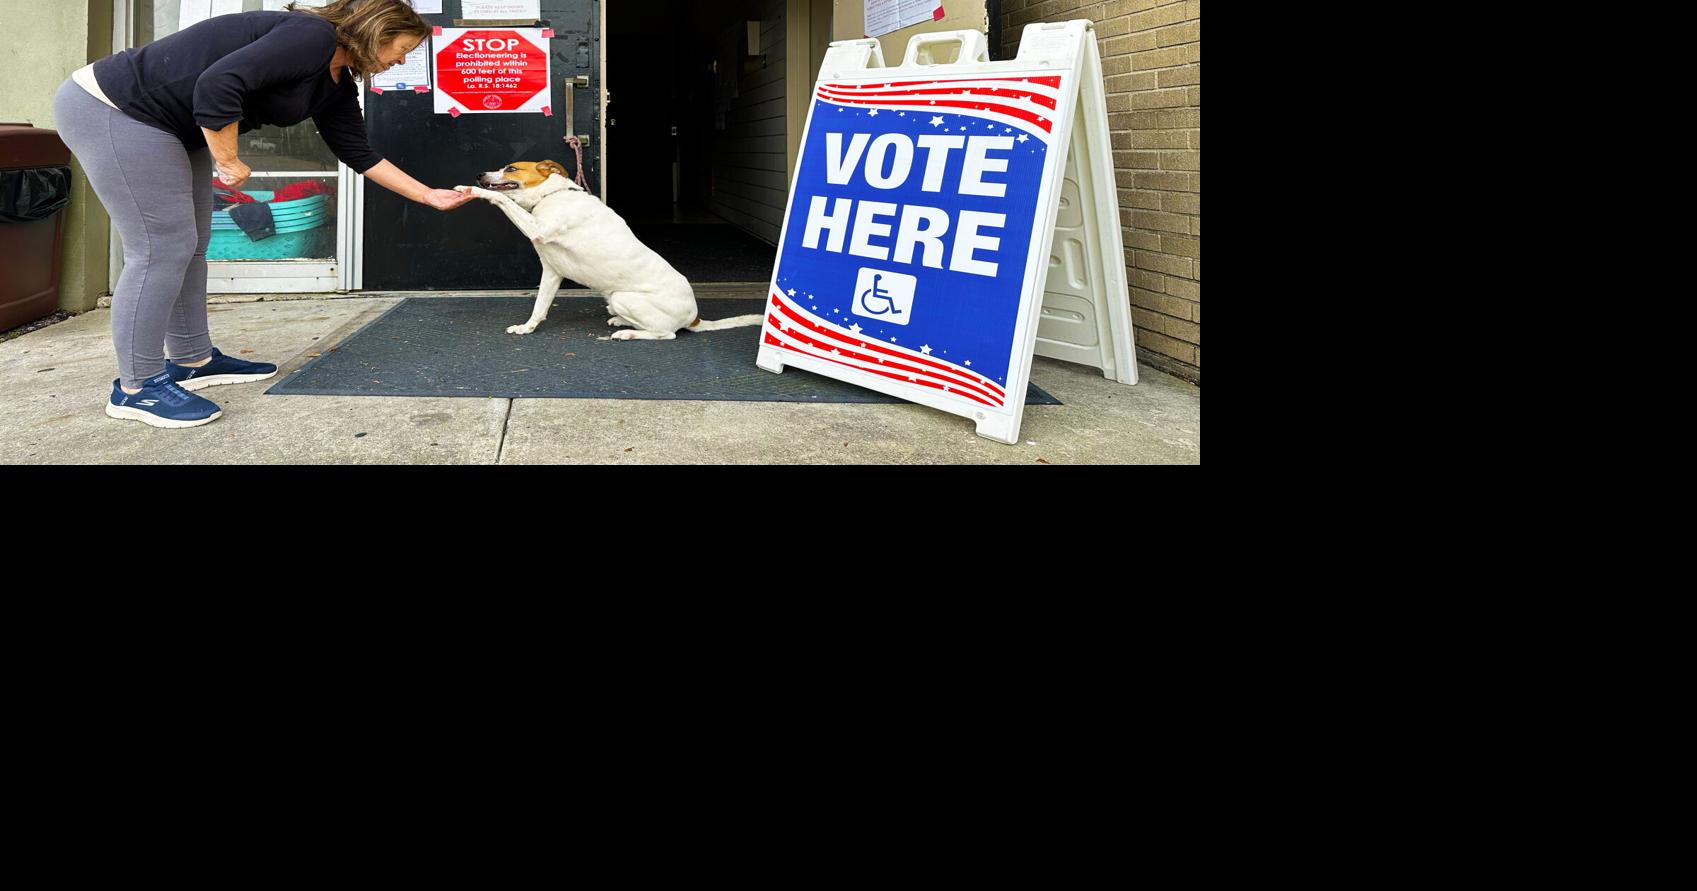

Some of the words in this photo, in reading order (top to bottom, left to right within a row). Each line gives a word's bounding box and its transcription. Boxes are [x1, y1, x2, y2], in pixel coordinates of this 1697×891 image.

[463, 38, 520, 52] STOP
[455, 60, 500, 68] prohibited
[463, 76, 493, 84] polling
[495, 76, 521, 84] place
[825, 132, 1015, 198] VOTE
[801, 195, 1007, 278] HERE
